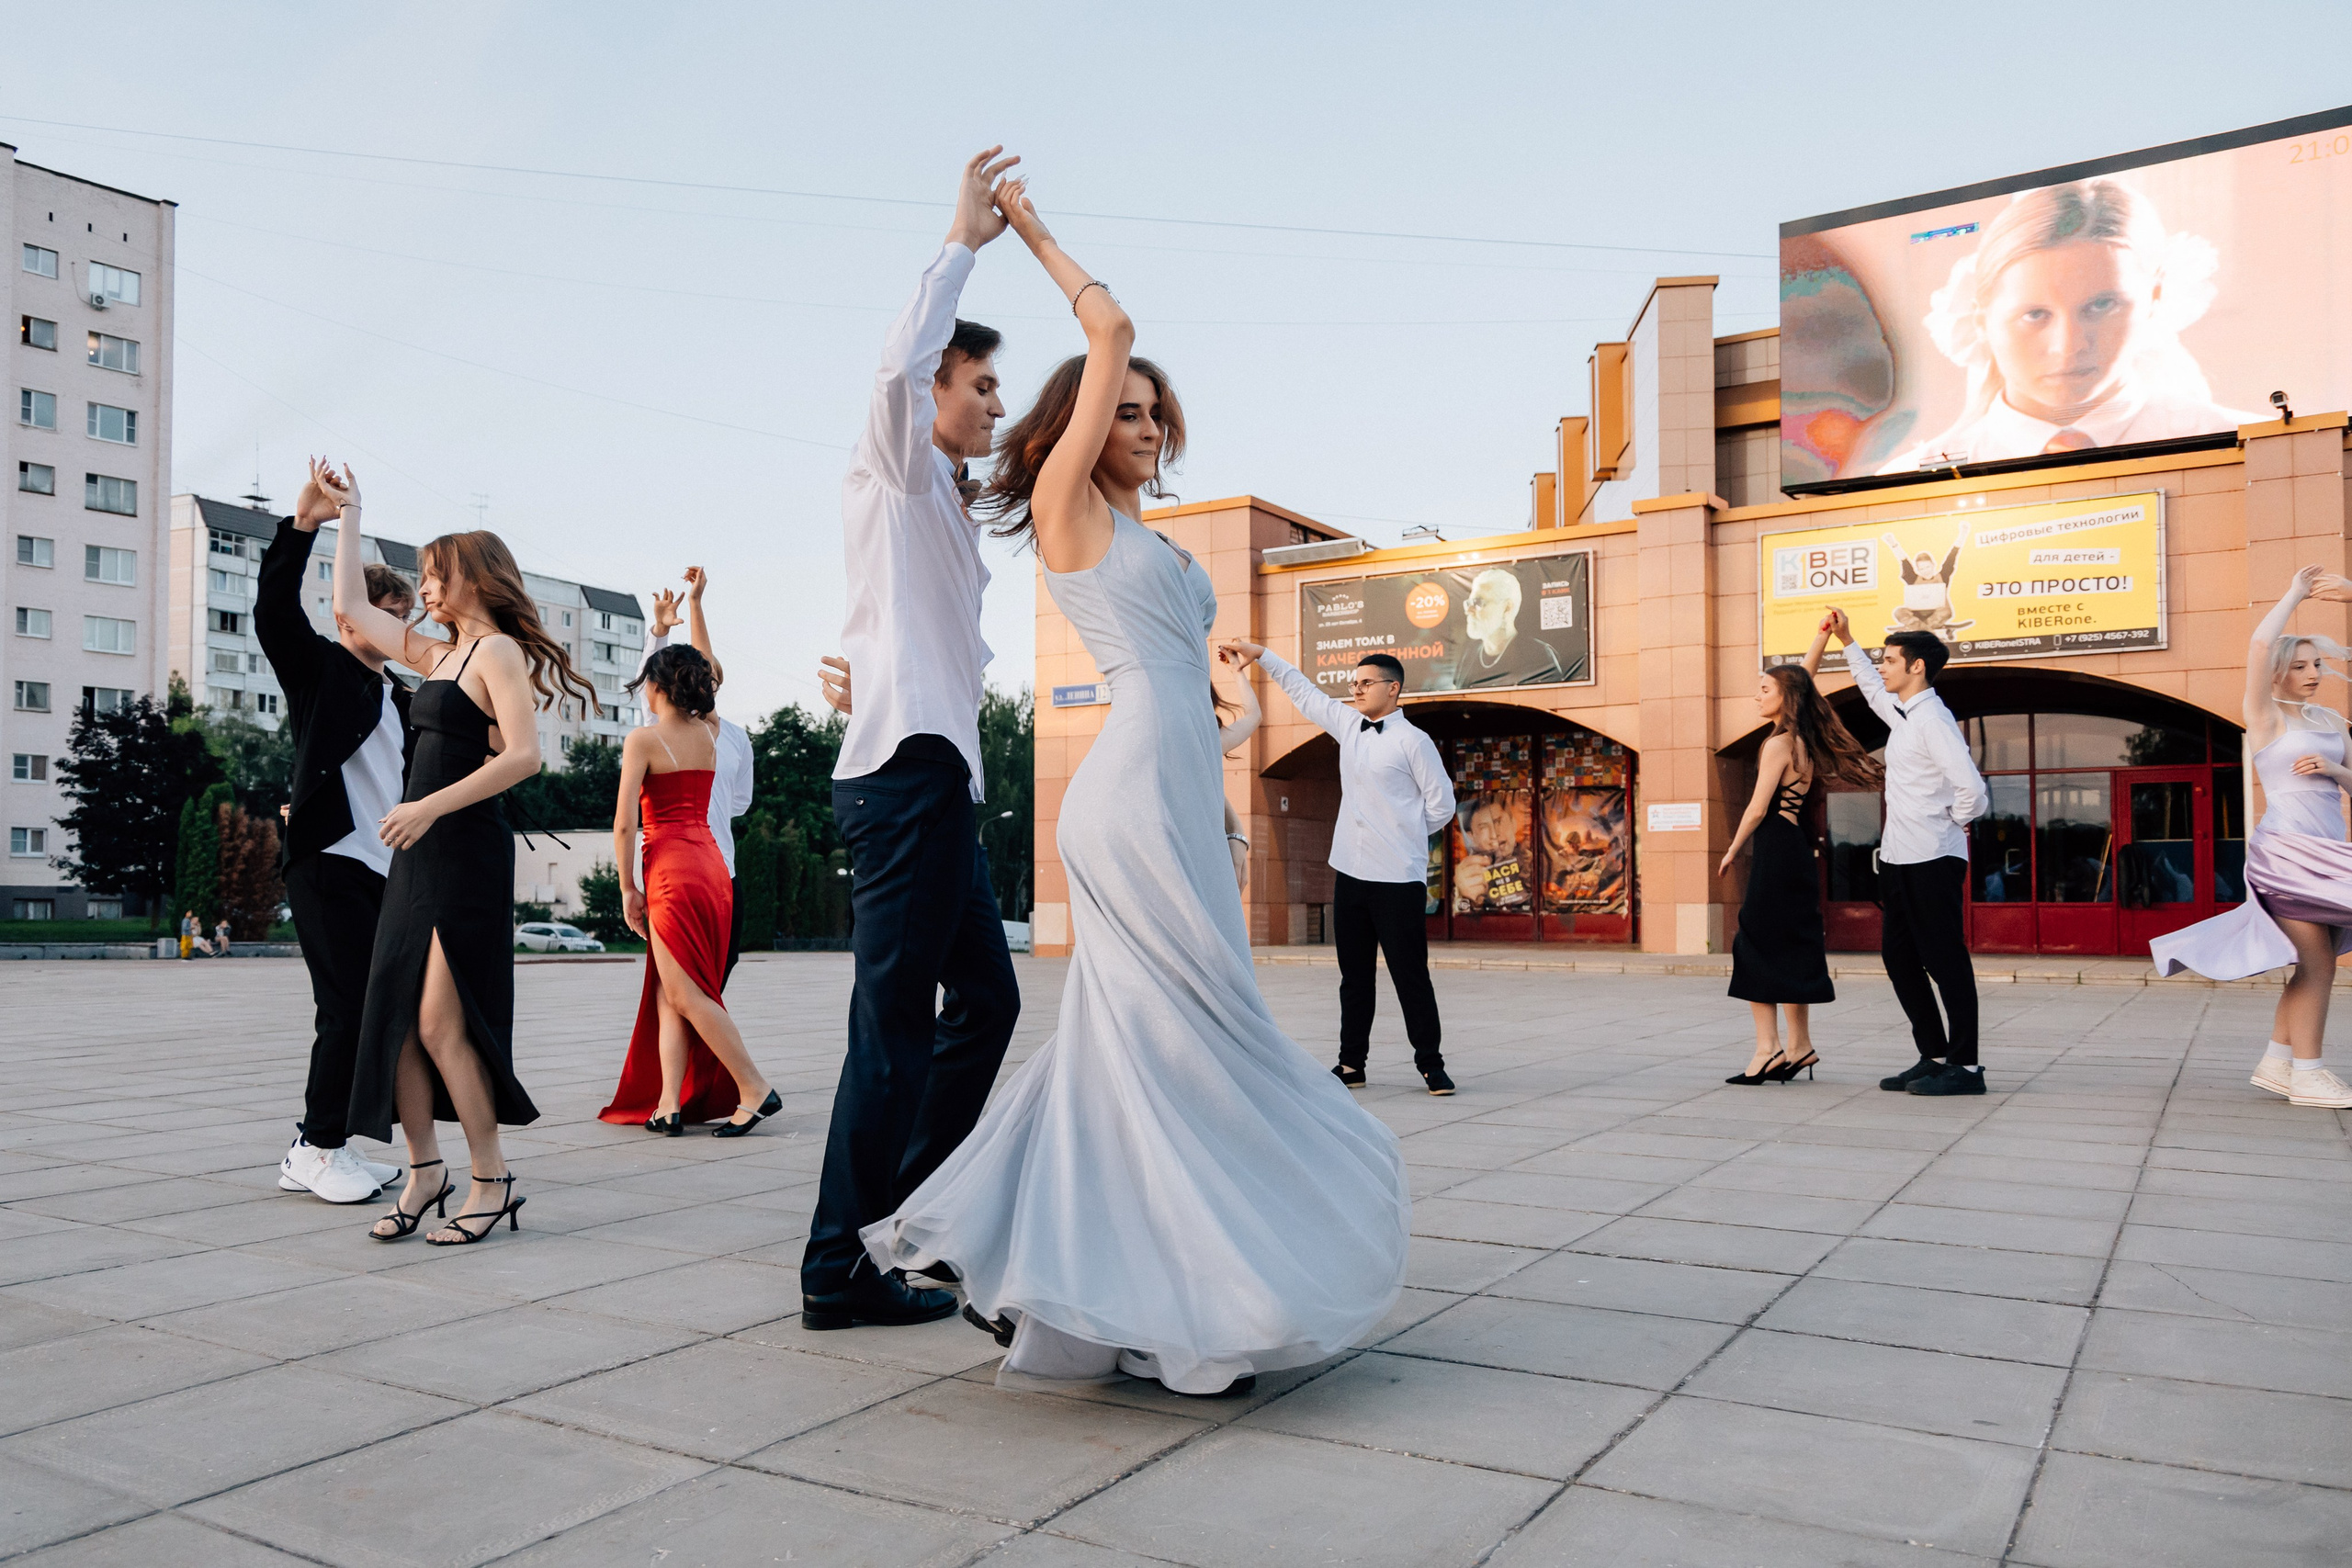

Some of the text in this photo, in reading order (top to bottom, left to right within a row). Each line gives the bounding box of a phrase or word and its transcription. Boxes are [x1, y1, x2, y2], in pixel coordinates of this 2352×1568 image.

[1980, 510, 2139, 545] Цифровые технологии
[2033, 554, 2059, 563] для
[2064, 551, 2104, 563] детей
[1810, 567, 1868, 588] ONE
[1983, 576, 2127, 596] ЭТО ПРОСТО!
[1410, 594, 1445, 608] -20%
[2018, 603, 2085, 615] вместе с
[2018, 616, 2097, 629] KIBERone.
[1317, 635, 1396, 650] ЗНАЕМ ТОЛК В
[2064, 630, 2150, 643] +7 (925) 4567-392
[1484, 863, 1520, 882] ВАСЯ
[1489, 880, 1524, 898] СЕБЕ
